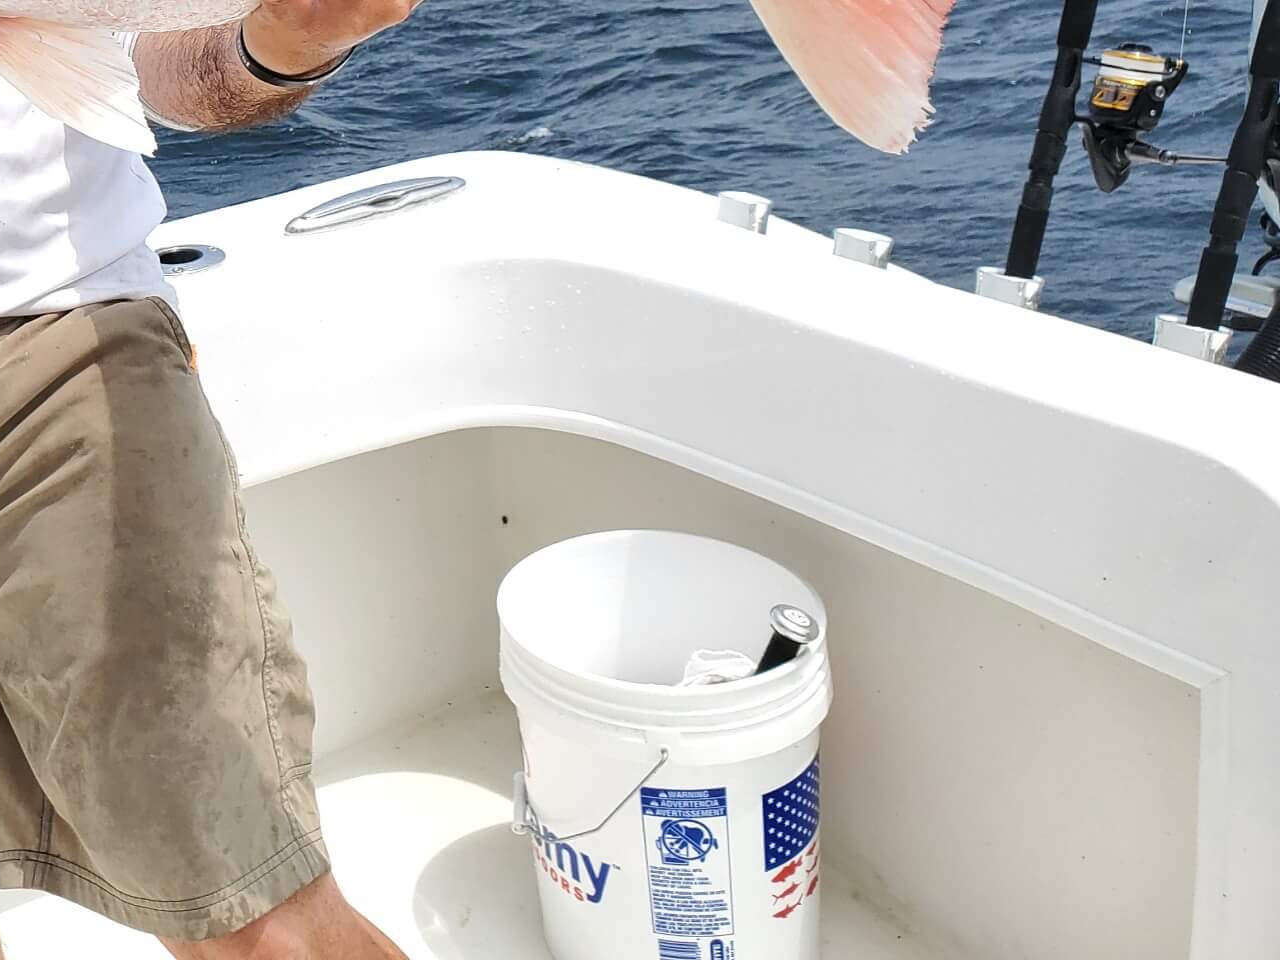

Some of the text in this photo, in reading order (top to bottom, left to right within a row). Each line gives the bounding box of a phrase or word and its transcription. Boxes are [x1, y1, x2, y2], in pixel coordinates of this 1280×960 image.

[667, 790, 710, 799] WARNING
[660, 800, 719, 808] ADVERTENCIA
[655, 808, 725, 817] AVERTISSEMENT
